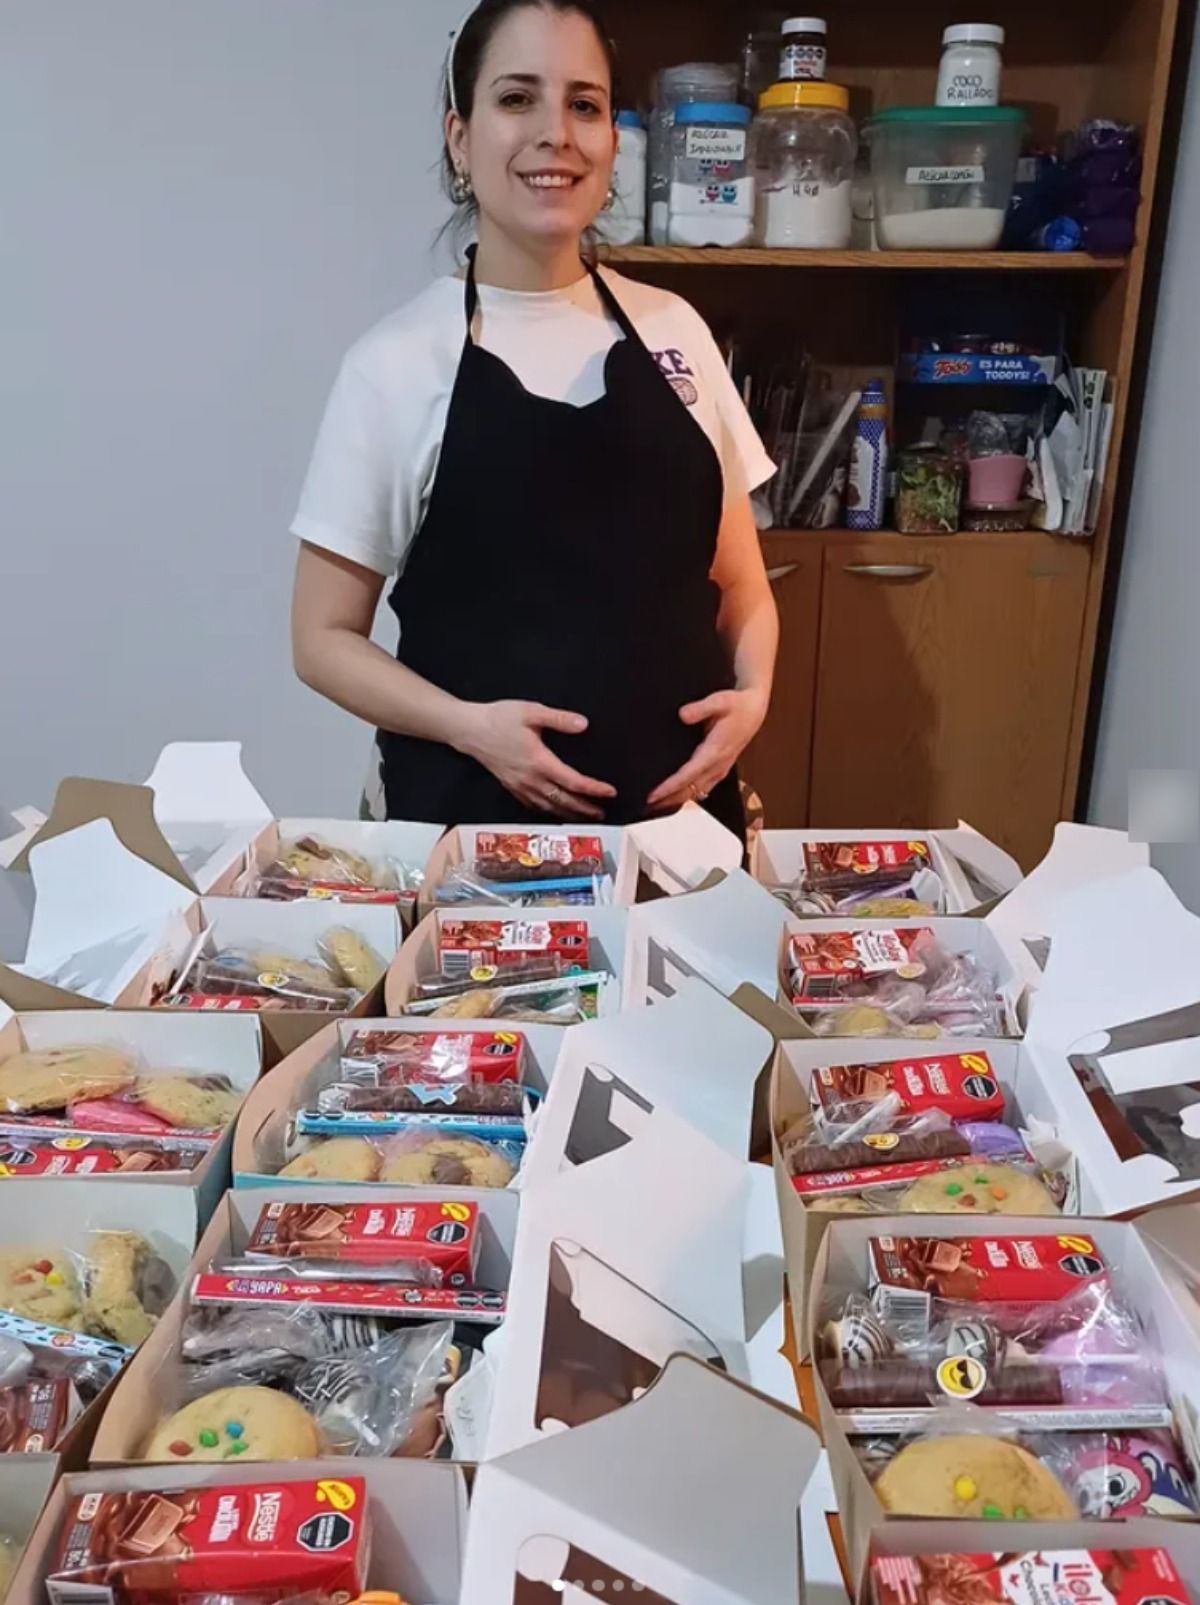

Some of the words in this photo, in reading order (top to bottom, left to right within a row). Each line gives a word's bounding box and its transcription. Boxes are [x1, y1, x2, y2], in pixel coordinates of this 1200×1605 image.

[952, 74, 983, 89] COCO
[979, 360, 993, 370] ES
[995, 360, 1023, 370] PARA
[1062, 1563, 1104, 1605] ilol
